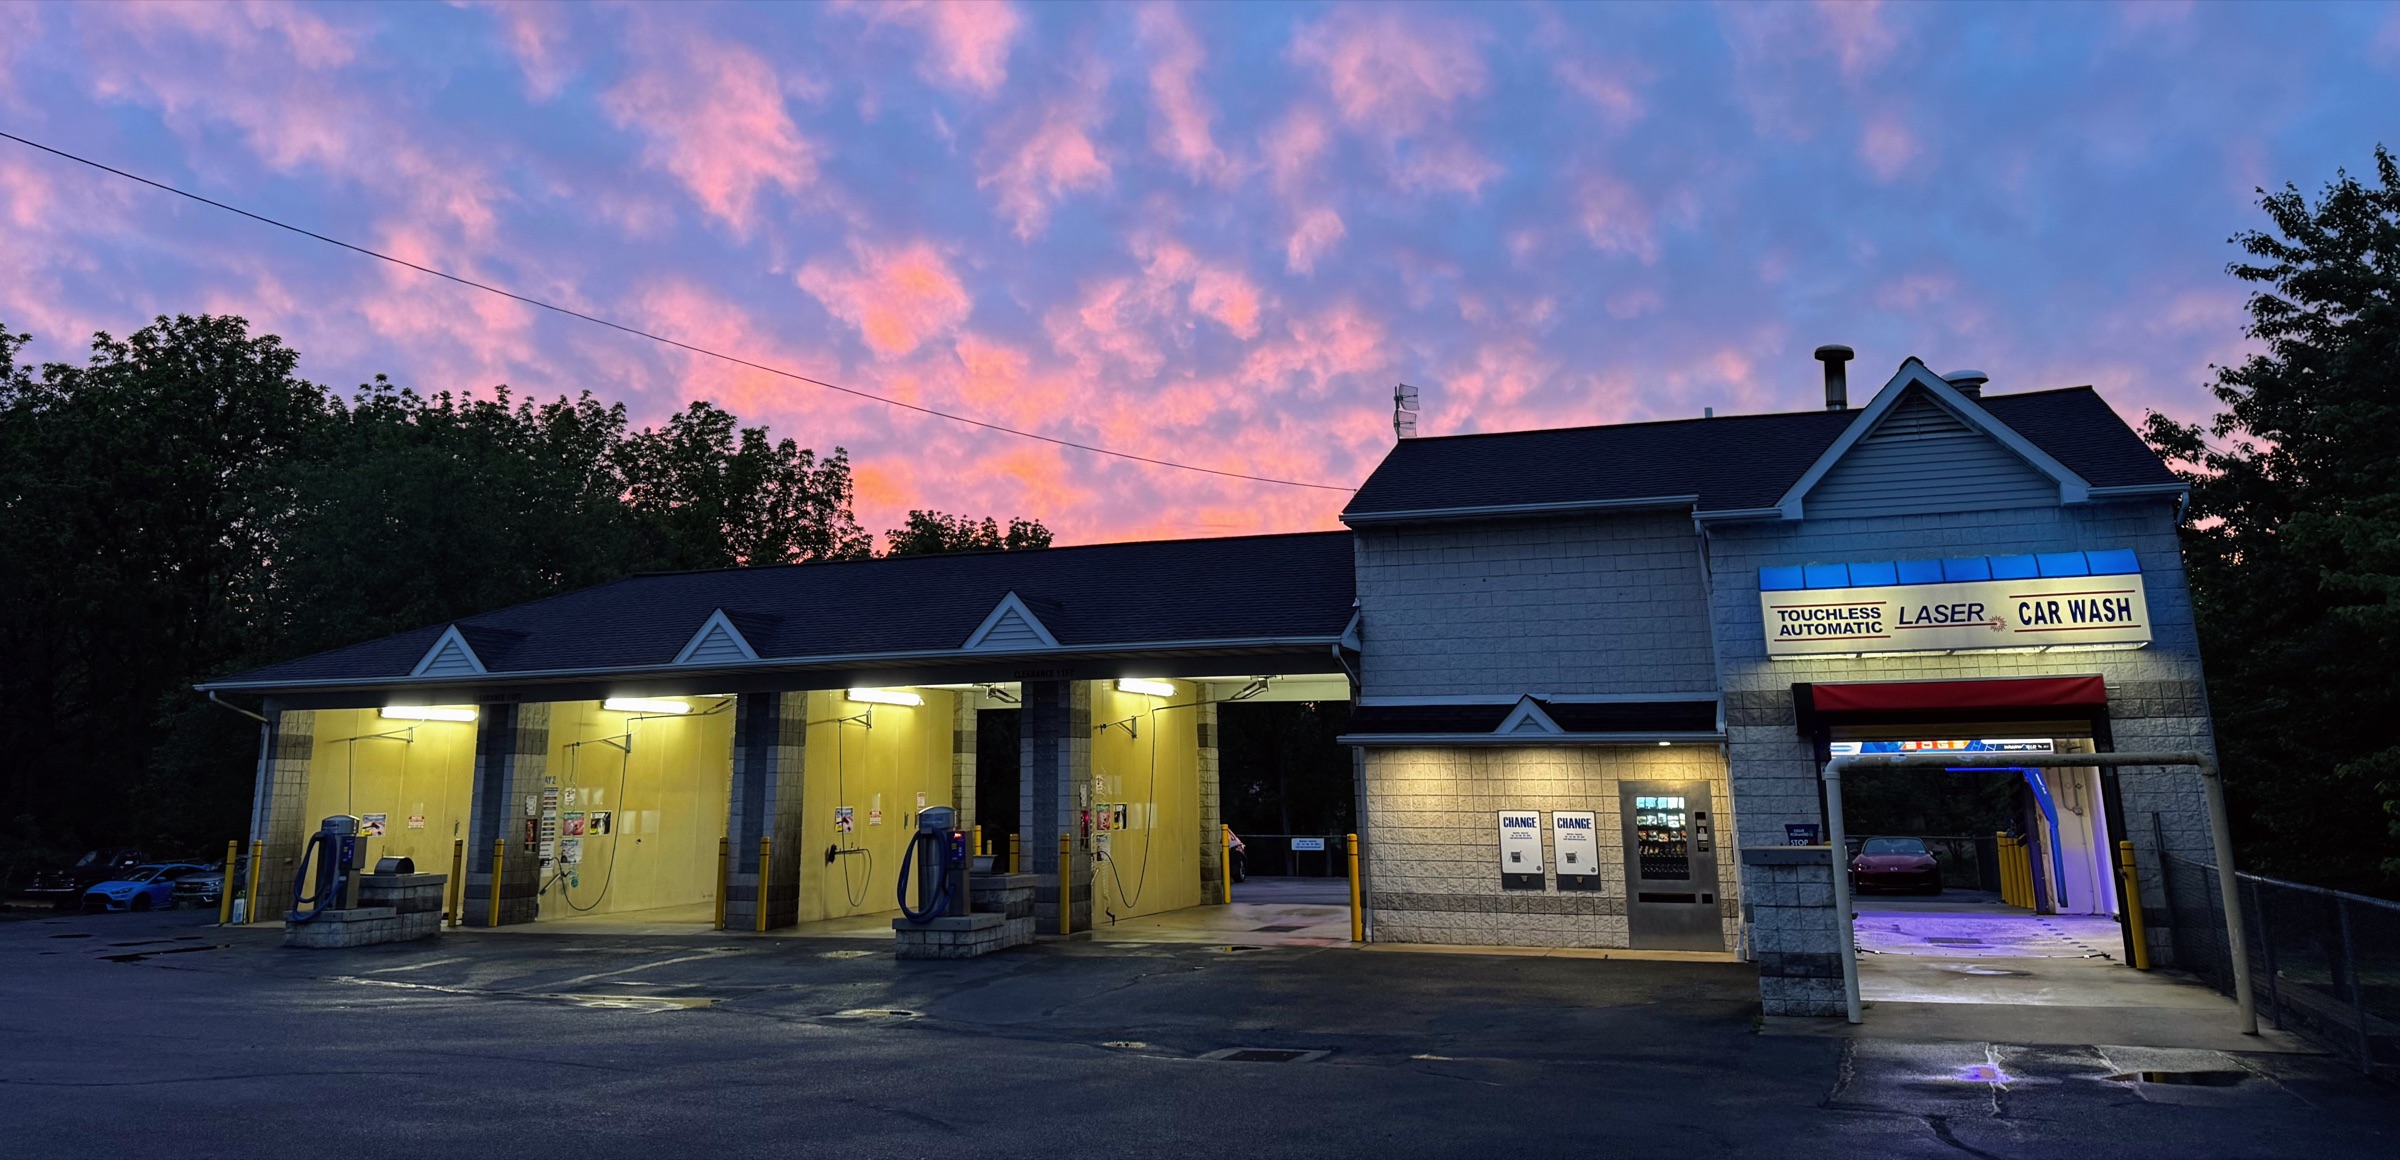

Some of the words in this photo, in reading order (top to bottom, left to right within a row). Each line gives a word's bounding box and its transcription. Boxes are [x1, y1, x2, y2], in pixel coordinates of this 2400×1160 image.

[1776, 607, 1882, 622] TOUCHLESS
[1898, 603, 1985, 625] LASER
[2018, 601, 2063, 626] CAR
[2067, 597, 2133, 623] WASH
[1779, 621, 1884, 636] AUTOMATIC
[1014, 669, 1054, 678] CLEARANCE
[1503, 817, 1537, 828] CHANGE
[1557, 817, 1592, 829] CHANGE
